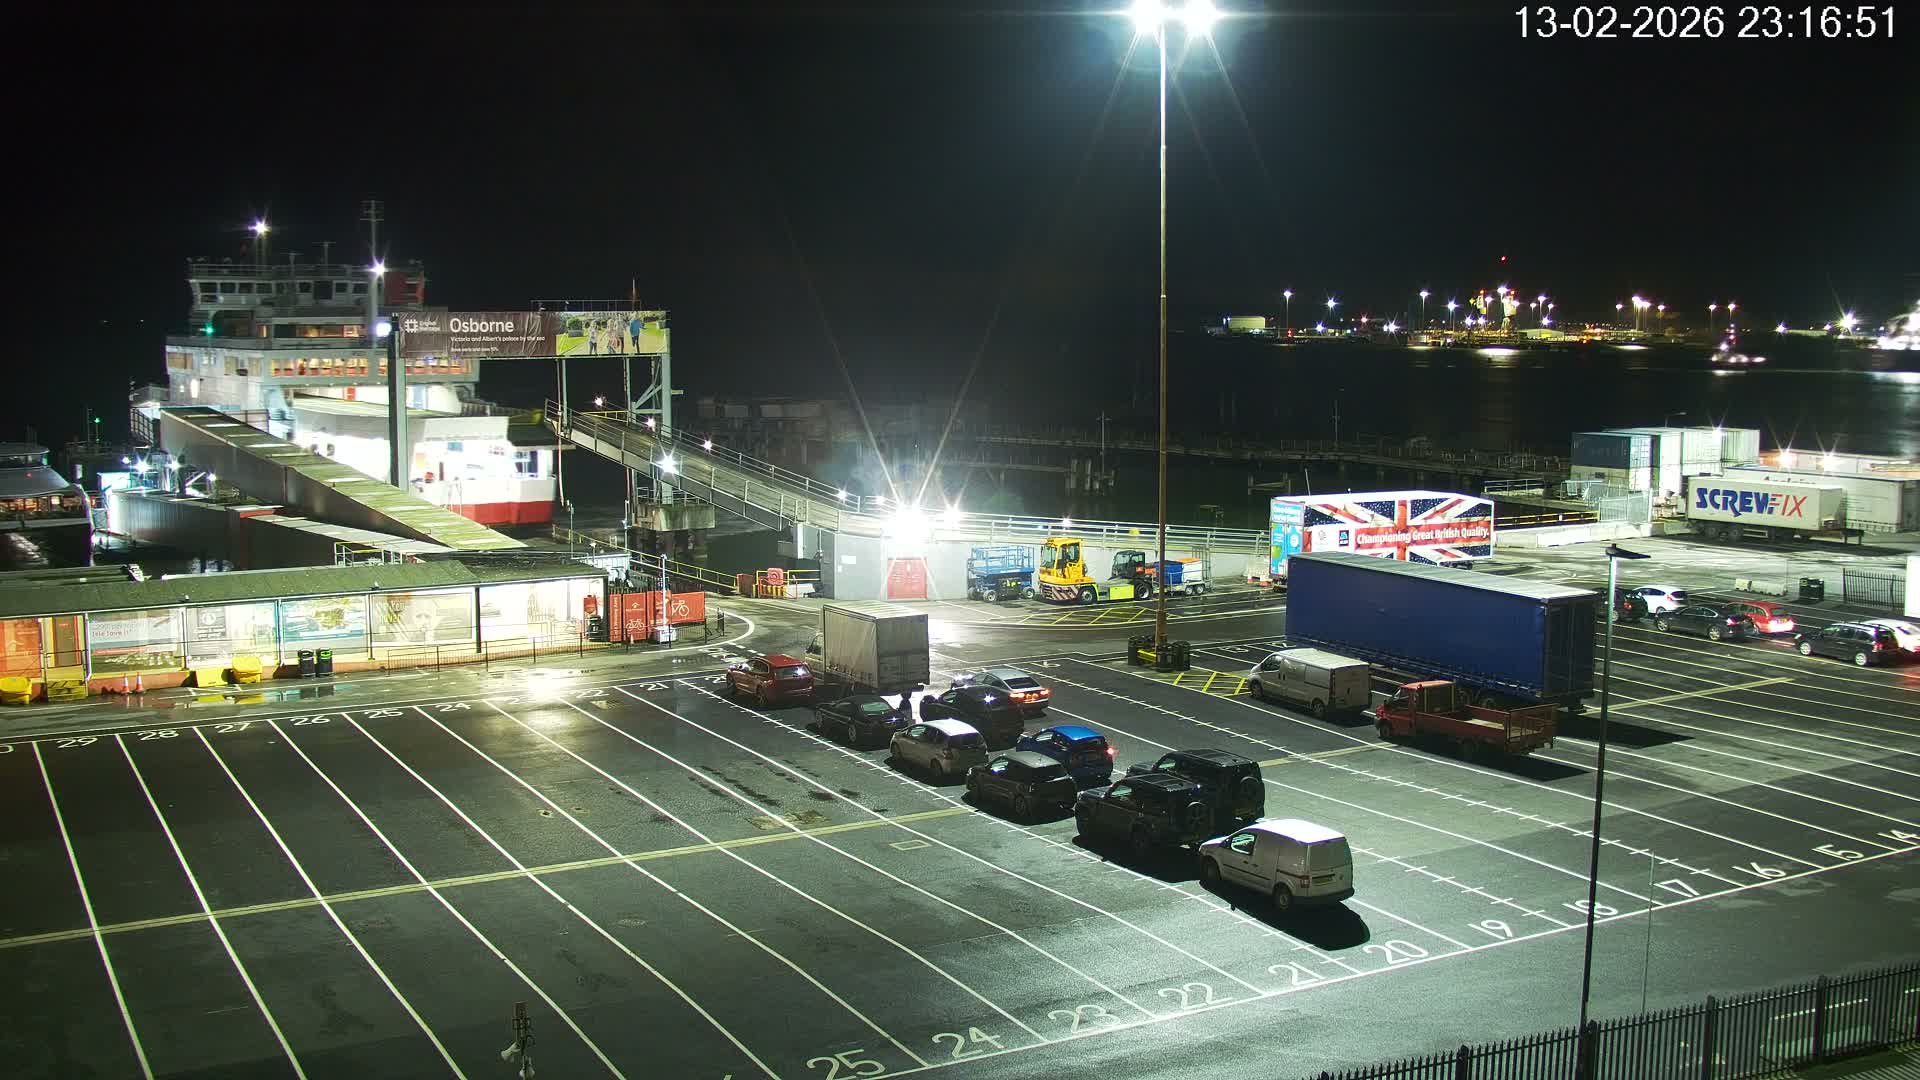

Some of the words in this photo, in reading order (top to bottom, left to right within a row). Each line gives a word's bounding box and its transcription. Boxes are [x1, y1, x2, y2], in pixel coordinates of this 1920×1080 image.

[449, 317, 514, 333] Osborne
[1696, 487, 1808, 518] SCREWFIX
[1357, 531, 1411, 545] Championing
[1412, 531, 1434, 541] Great
[1434, 528, 1460, 540] British
[1461, 526, 1489, 539] Quality.
[637, 683, 670, 691] 21
[364, 708, 405, 719] 25
[435, 701, 472, 713] 24
[214, 721, 252, 734] 27
[290, 715, 331, 726] 26
[57, 735, 98, 749] 29
[138, 729, 180, 742] 28
[1876, 829, 1920, 846] 14
[1812, 844, 1865, 862] 15
[1732, 862, 1787, 880] 16
[1654, 878, 1701, 898] 17
[1561, 899, 1619, 919] 18
[1467, 918, 1514, 941] 19
[1363, 938, 1430, 966] 20
[1267, 959, 1326, 987] 21
[1157, 981, 1231, 1012] 22
[1047, 1003, 1122, 1033] 23
[931, 1026, 1005, 1058] 24
[806, 1048, 886, 1080] 25
